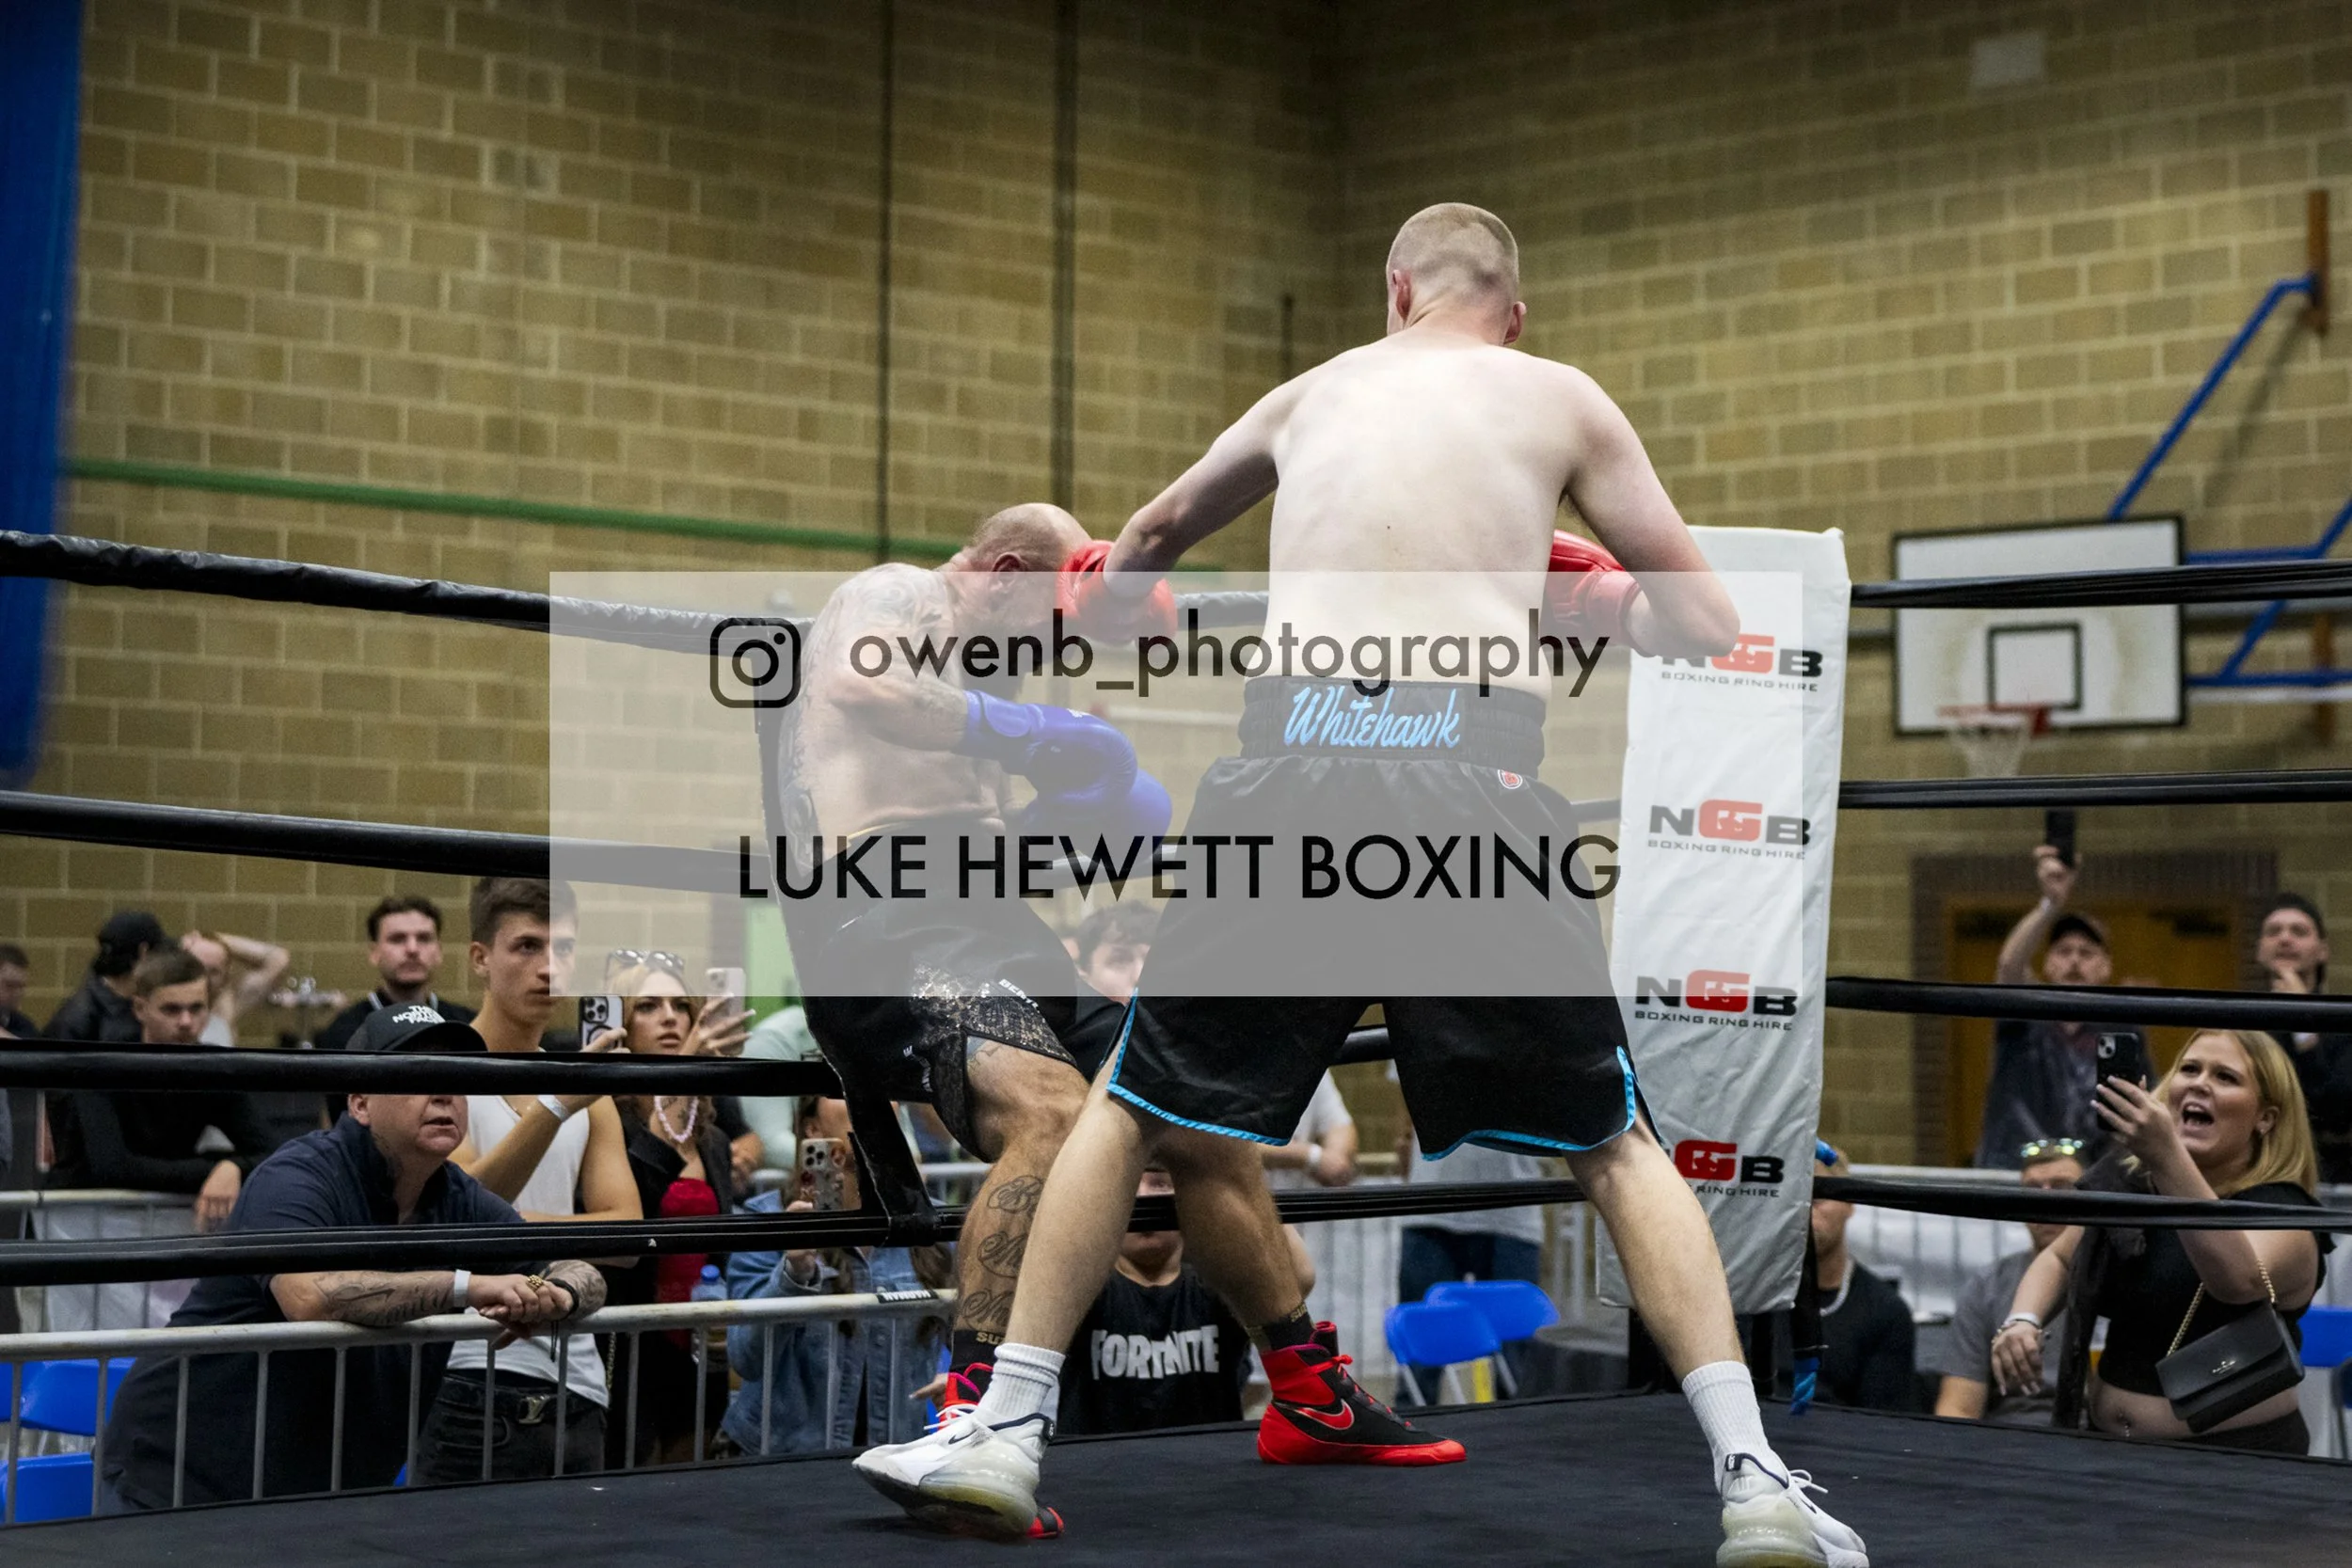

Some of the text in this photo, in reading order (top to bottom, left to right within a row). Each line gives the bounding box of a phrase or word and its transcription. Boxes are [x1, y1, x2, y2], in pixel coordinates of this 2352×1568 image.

[1661, 672, 1819, 692] BOXING RING HIRE
[1283, 686, 1460, 749] Whitehawk
[1649, 800, 1811, 846] NGB
[1648, 840, 1806, 861] BOXING RING HIRE
[1635, 970, 1798, 1016] NGB
[1635, 1010, 1793, 1032] BOXING RING HIRE
[1664, 1140, 1785, 1184] GB
[1696, 1185, 1780, 1198] RING HIRE
[1090, 1324, 1220, 1381] FORTNITE
